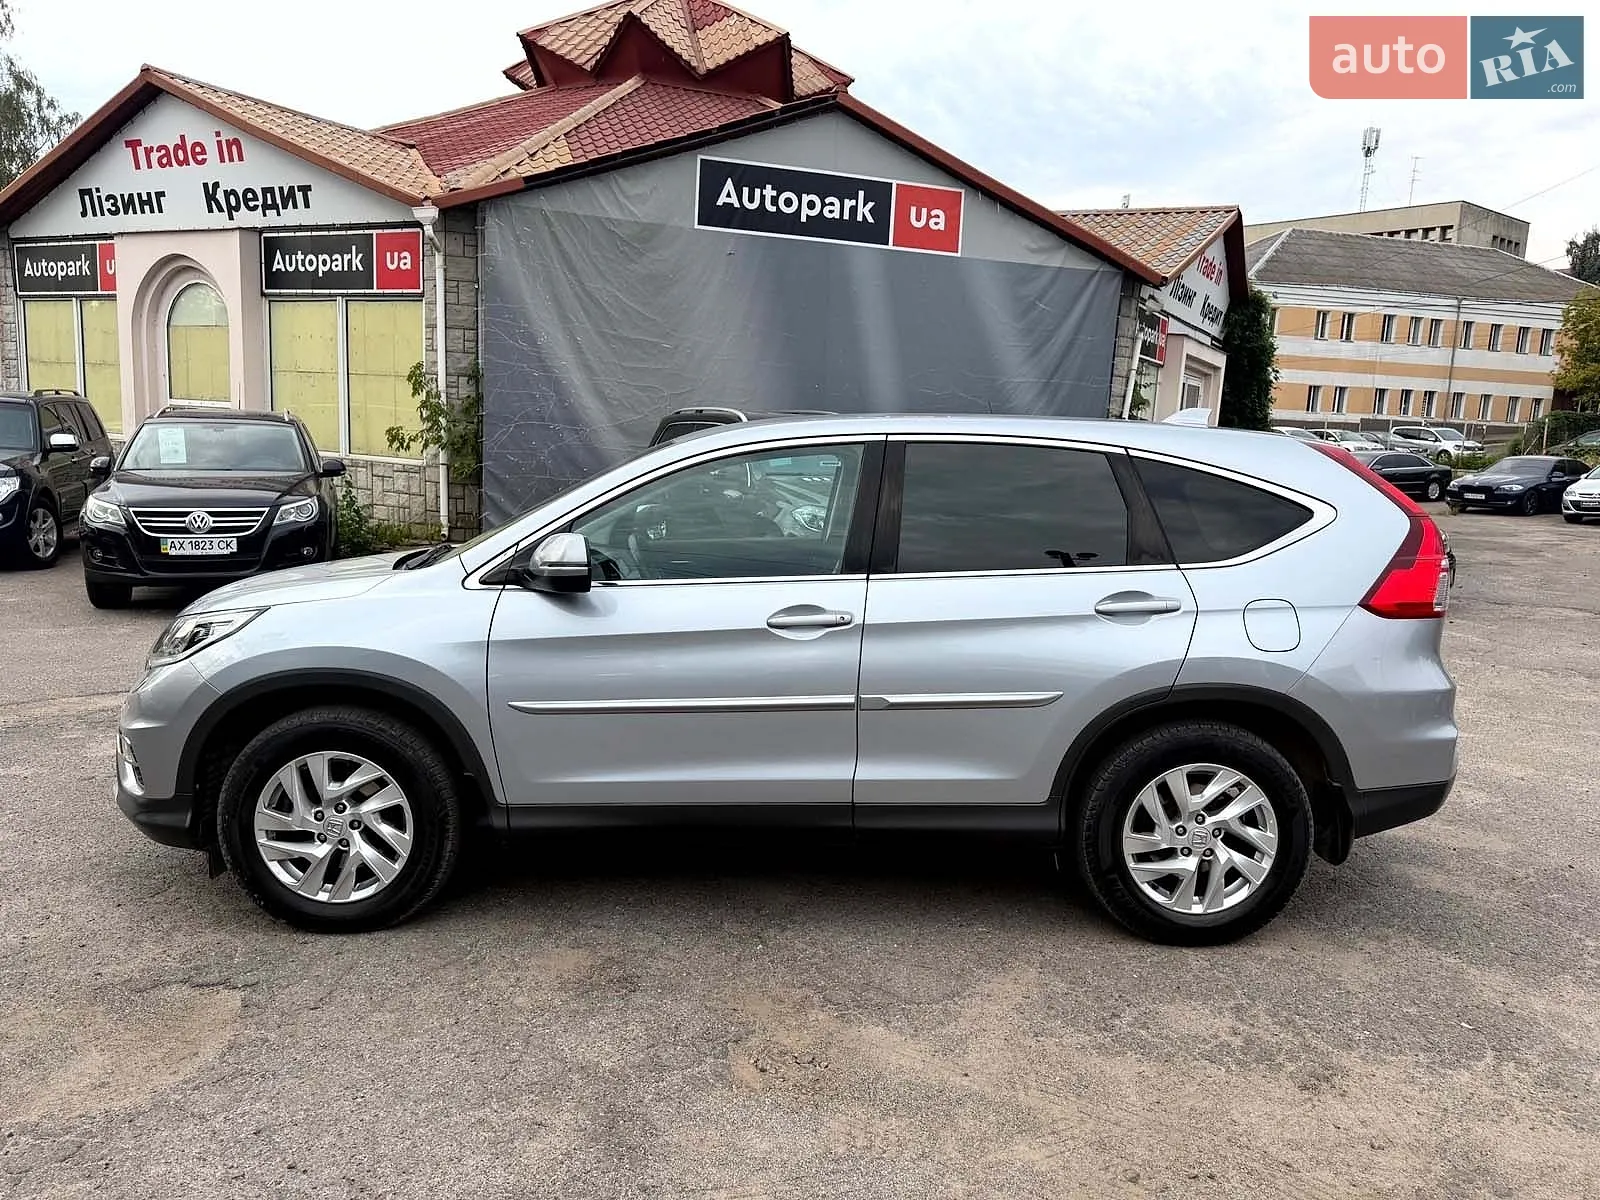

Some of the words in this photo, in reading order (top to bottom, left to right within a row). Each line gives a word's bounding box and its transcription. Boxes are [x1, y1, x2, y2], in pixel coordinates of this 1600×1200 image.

[124, 135, 208, 170] Trade
[214, 131, 245, 163] in
[78, 187, 166, 218] Лізинг
[202, 181, 313, 221] Кредит
[715, 177, 875, 224] Autopark
[909, 205, 946, 231] ua
[24, 253, 91, 281] Autopark
[106, 259, 115, 275] u
[271, 245, 364, 277] Autopark
[386, 250, 411, 270] ua
[1169, 274, 1197, 309] Лізинг
[1200, 293, 1223, 328] Кредит
[169, 540, 186, 551] AX
[188, 540, 214, 551] 1823
[217, 540, 234, 551] CK
